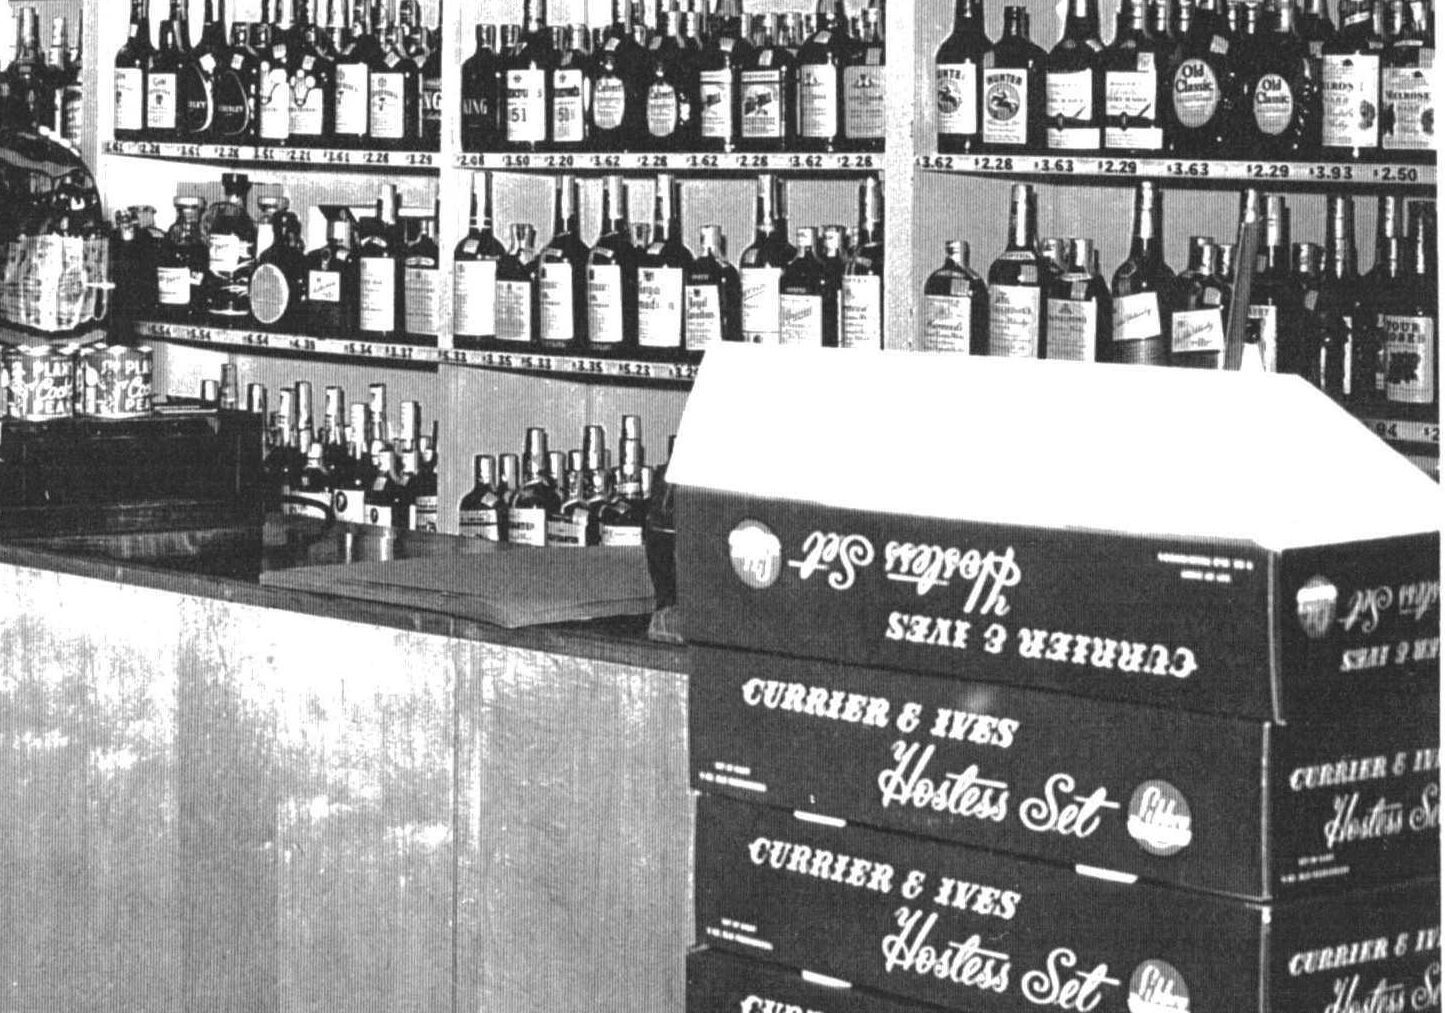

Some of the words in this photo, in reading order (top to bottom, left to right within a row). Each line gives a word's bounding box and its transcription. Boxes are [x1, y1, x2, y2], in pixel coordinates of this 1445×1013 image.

[986, 73, 1023, 86] HUNTER
[1175, 78, 1214, 93] Classic
[1181, 63, 1205, 79] Old
[1261, 78, 1282, 91] Old
[511, 108, 527, 122] 51
[1256, 91, 1290, 105] Classic
[502, 155, 531, 166] $3.50
[544, 155, 574, 166] $2.20
[589, 155, 620, 166] $3.62
[637, 155, 668, 167] $2.28
[686, 155, 718, 167] $3.62
[736, 155, 769, 167] $2.28
[788, 155, 823, 167] $3.62
[837, 155, 873, 167] $2.28
[916, 155, 954, 170] $3.62
[974, 156, 1014, 171] $2.28
[1034, 158, 1074, 173] $3.63
[1098, 160, 1137, 174] $2.29
[1167, 162, 1209, 177] $3.63
[1247, 163, 1290, 178] $2.29
[1309, 165, 1353, 180] $3.93
[1373, 167, 1418, 182] $2.50
[521, 356, 553, 370] $5.33
[571, 360, 604, 373] $3.35
[787, 530, 875, 590] Set
[884, 540, 1022, 616] Hostess
[885, 611, 971, 649] IVES
[983, 623, 1007, 654] &
[1019, 628, 1198, 678] CURRIER
[741, 677, 891, 728] CURRIER
[896, 701, 923, 734] &
[930, 707, 1021, 749] IVES
[877, 739, 1010, 823] Hostess
[1019, 772, 1121, 839] Set
[1288, 755, 1387, 791] CURRIER
[1391, 752, 1407, 776] &
[1324, 789, 1404, 850] Hostess
[1408, 782, 1439, 831] Se
[747, 837, 895, 895] CURRIER
[901, 869, 927, 900] &
[933, 876, 1022, 921] IVES
[881, 905, 1012, 994] Hostess
[1021, 947, 1121, 1013] Set
[1287, 936, 1389, 978] CURRIER
[1393, 931, 1408, 957] &
[1324, 973, 1405, 1013] Hostess
[1410, 961, 1439, 1011] Se
